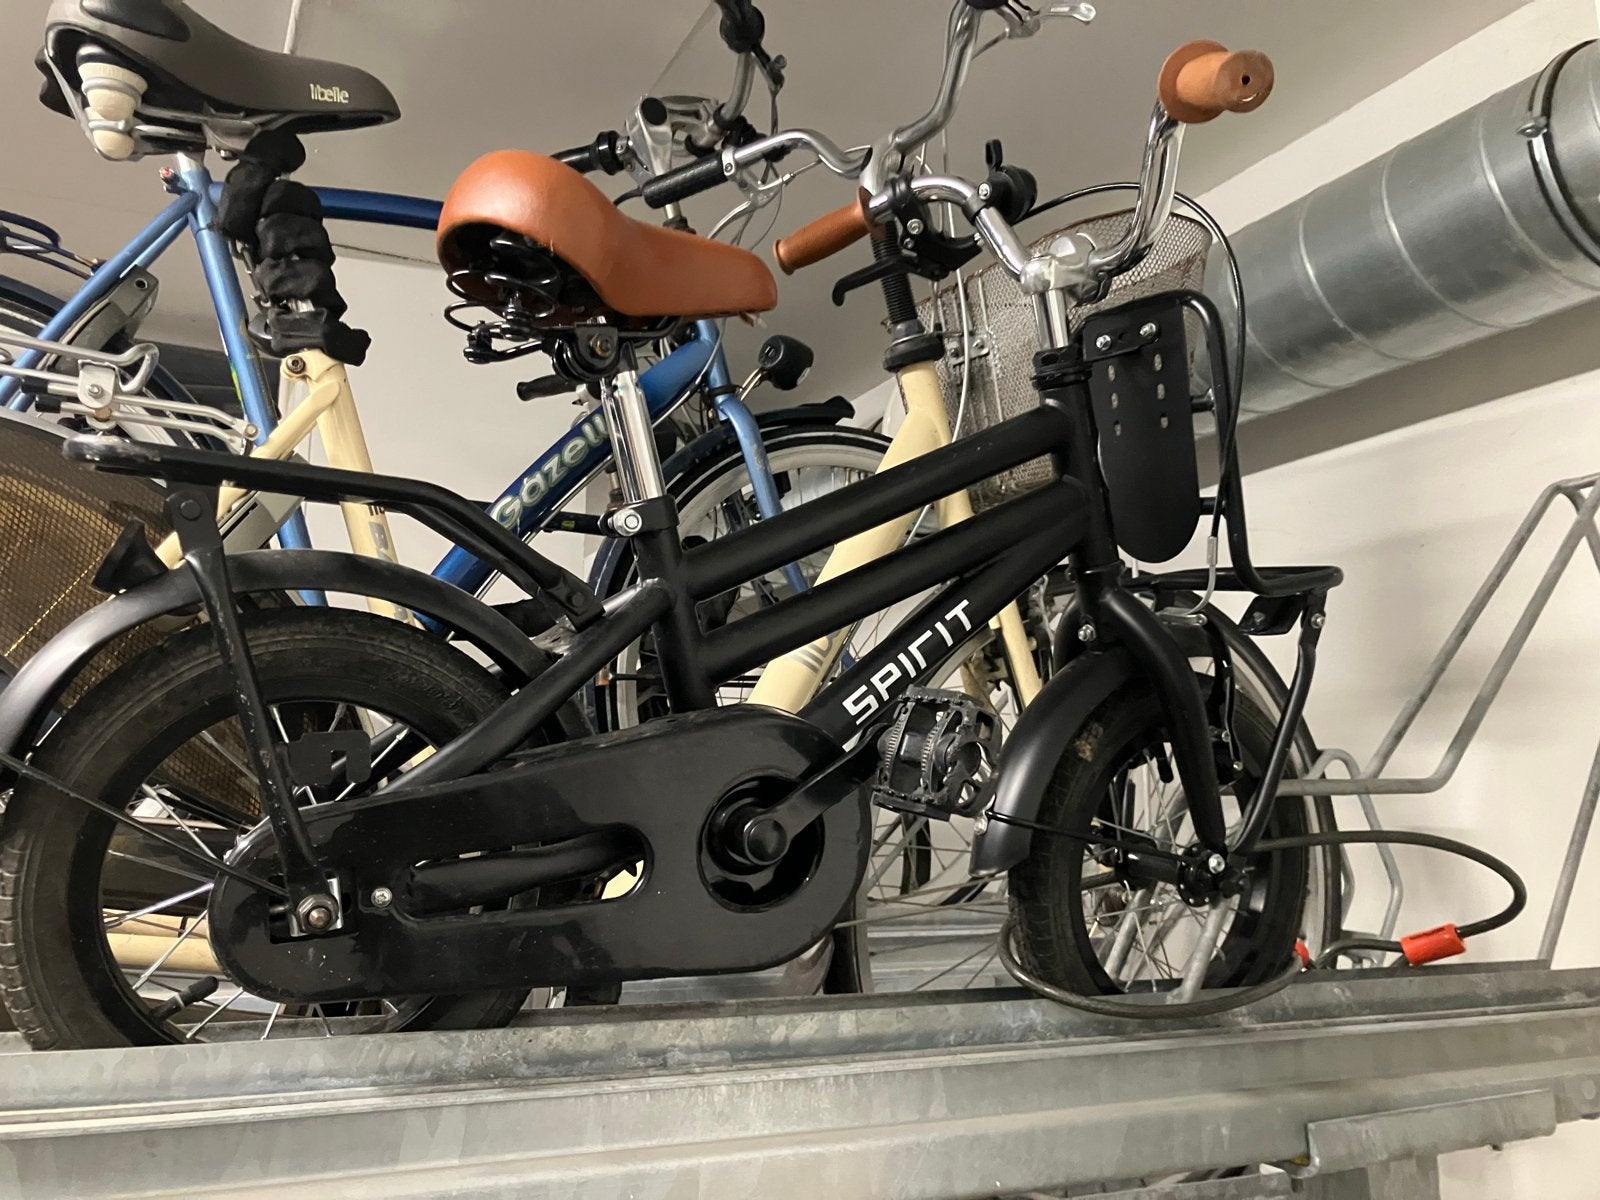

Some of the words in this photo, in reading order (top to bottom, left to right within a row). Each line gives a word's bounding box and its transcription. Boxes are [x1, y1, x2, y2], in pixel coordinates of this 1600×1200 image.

[309, 83, 350, 104] libelle
[490, 412, 610, 529] Gazell
[841, 599, 972, 726] SPIRIT
